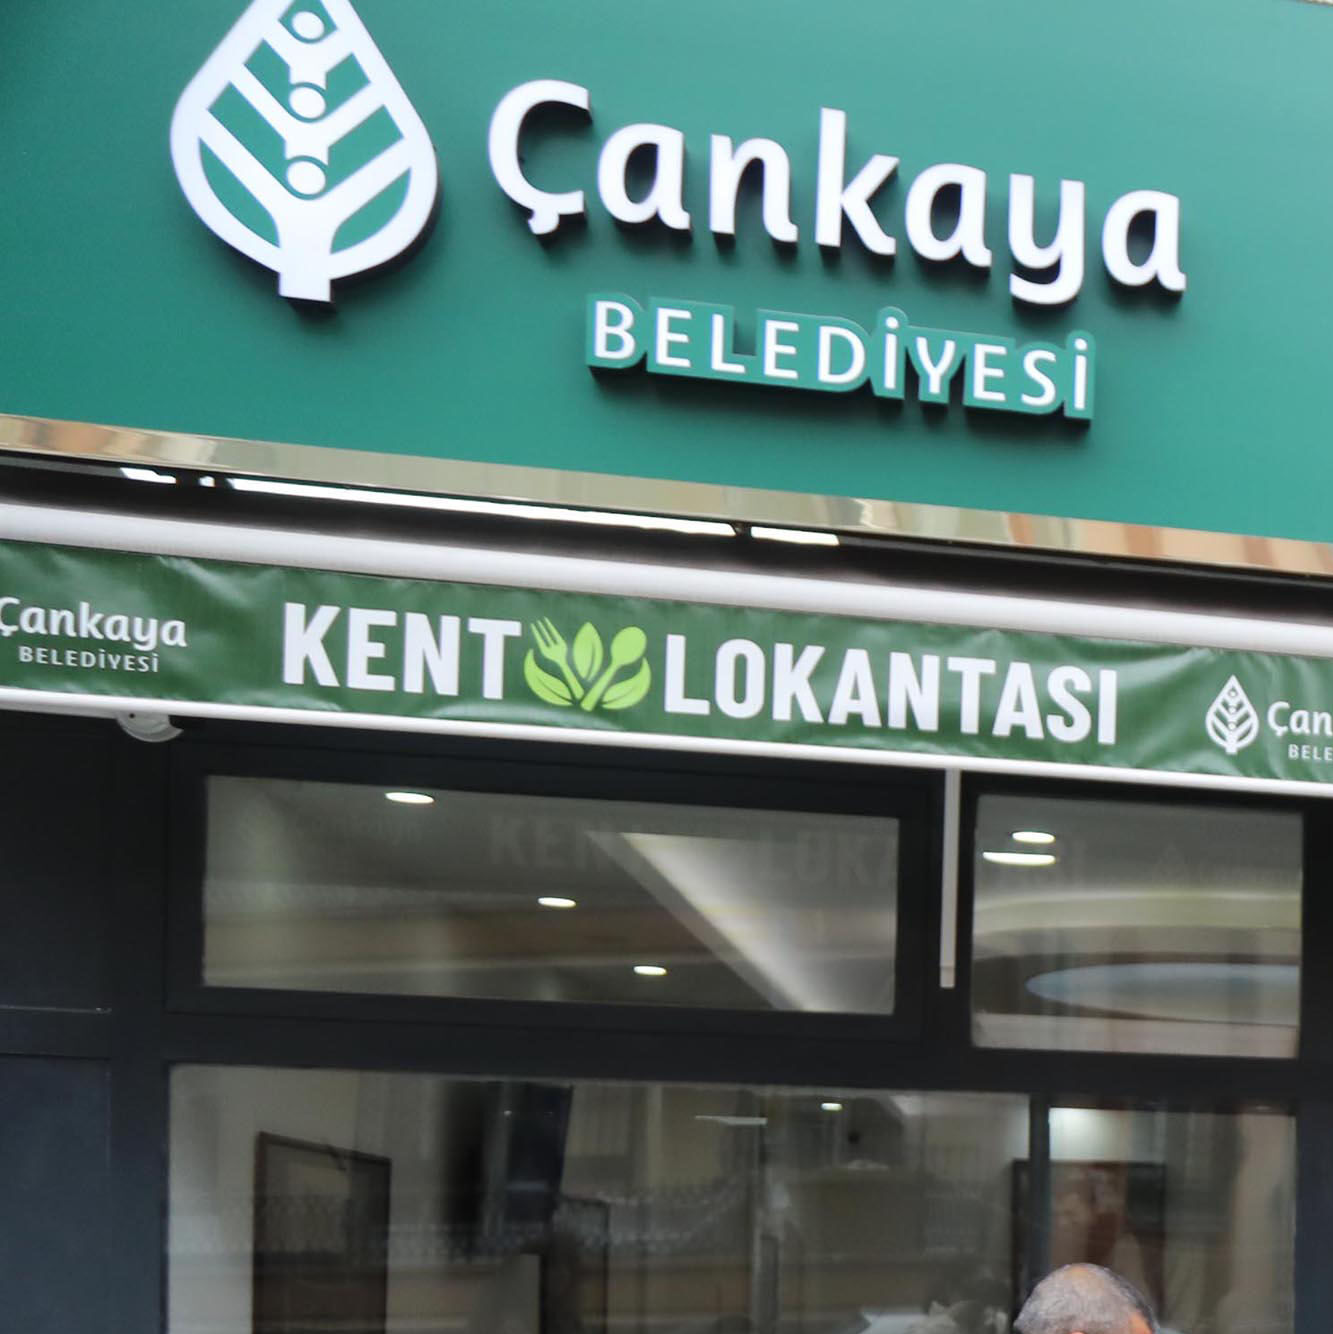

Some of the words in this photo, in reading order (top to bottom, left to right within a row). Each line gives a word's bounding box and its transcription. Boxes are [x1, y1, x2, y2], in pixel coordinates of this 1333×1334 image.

[487, 78, 1188, 307] Çankaya
[592, 298, 1093, 412] BELEDİYESİ
[0, 596, 188, 652] Çankaya
[19, 645, 159, 673] BELEDİYESİ
[283, 602, 522, 700] KENT
[663, 633, 1119, 747] LOKANTASI
